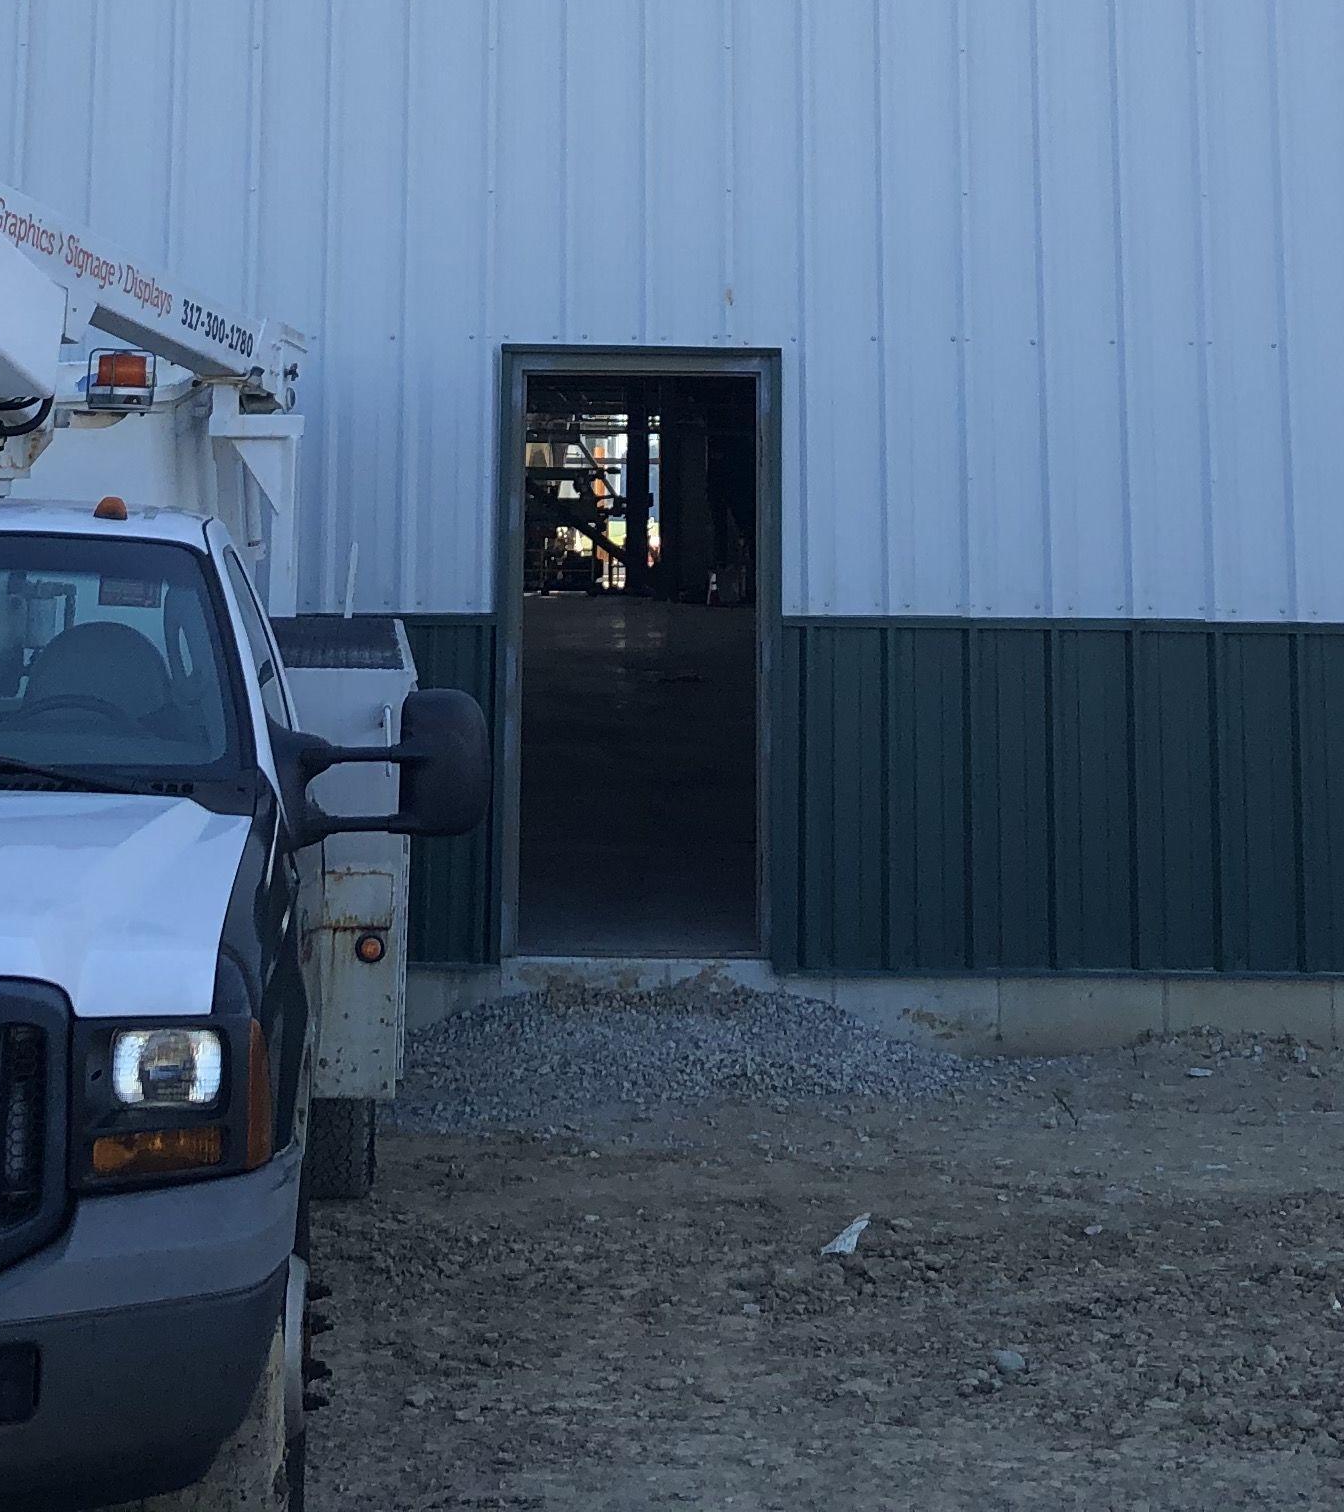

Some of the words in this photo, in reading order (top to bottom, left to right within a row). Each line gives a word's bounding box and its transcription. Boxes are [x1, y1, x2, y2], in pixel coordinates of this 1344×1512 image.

[65, 234, 115, 289] Signage
[122, 264, 173, 317] Displays
[181, 299, 254, 358] 317-300-1780
